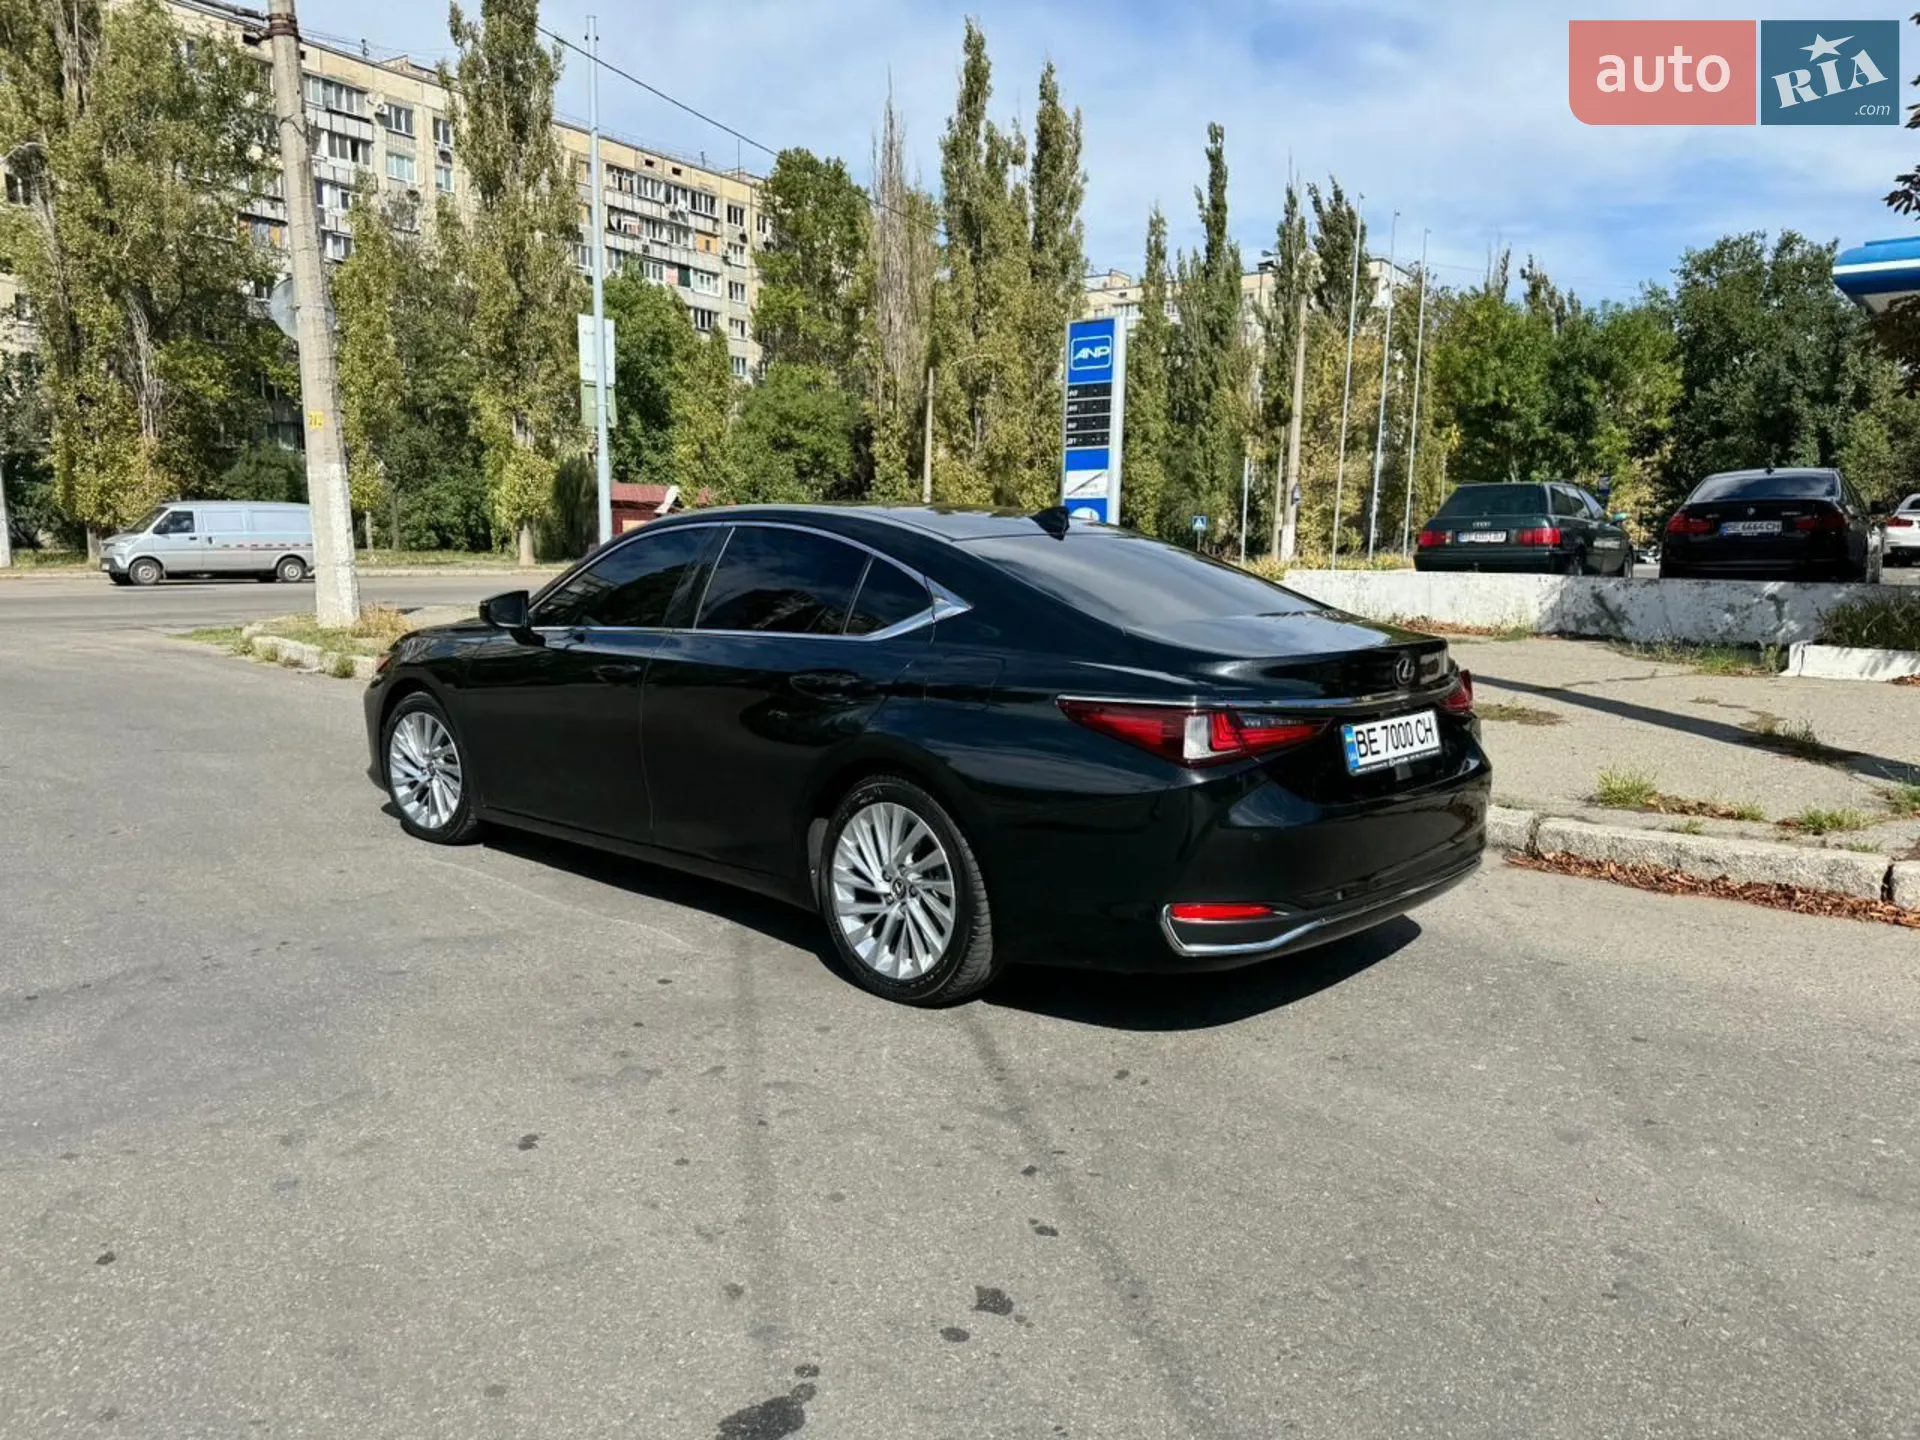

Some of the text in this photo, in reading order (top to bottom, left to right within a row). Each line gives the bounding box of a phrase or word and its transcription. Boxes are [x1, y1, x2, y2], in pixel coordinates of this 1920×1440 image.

[1355, 717, 1434, 757] BE 7000 CH
